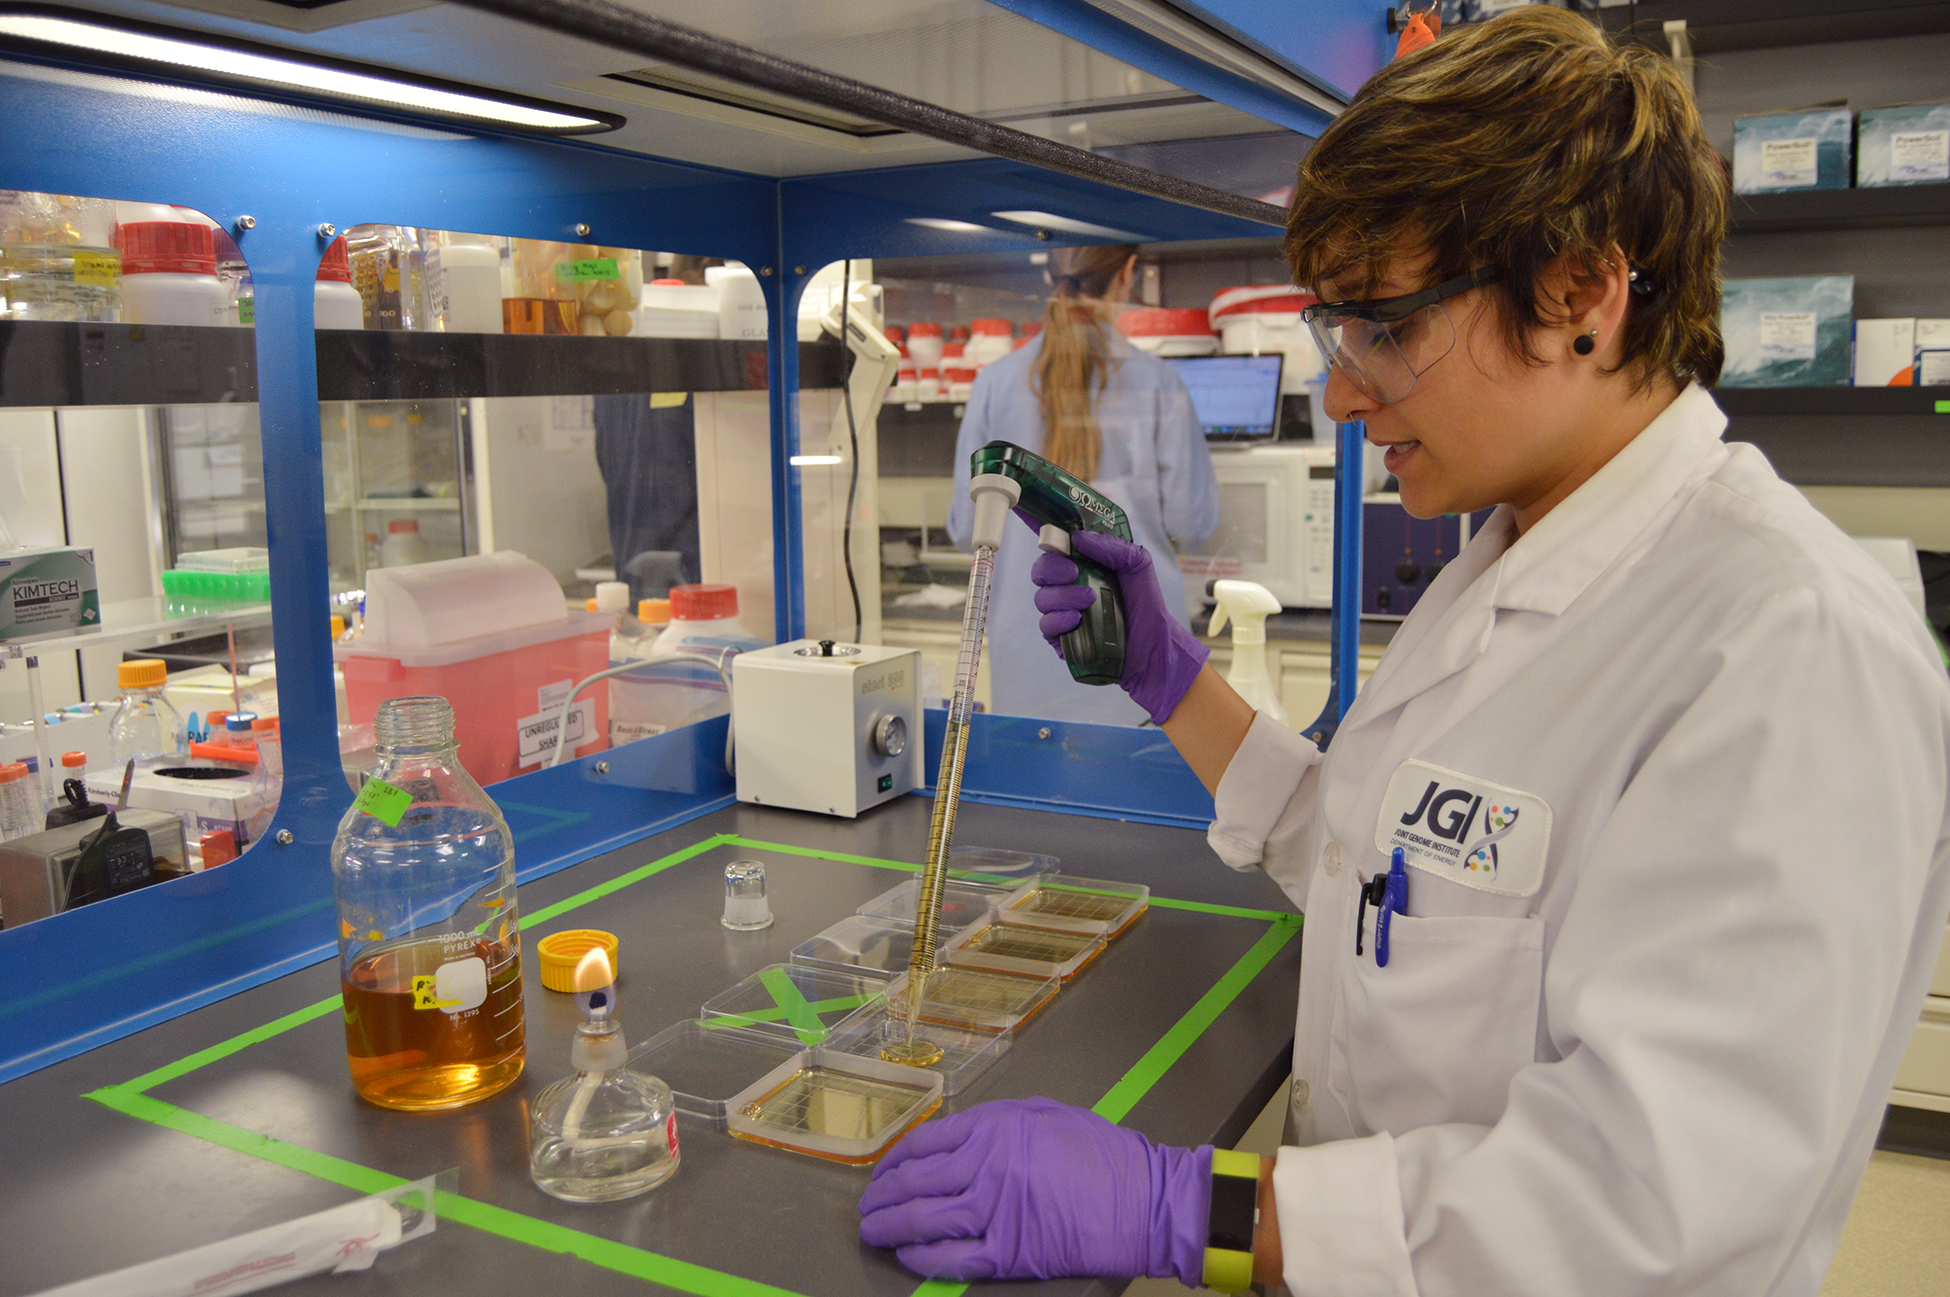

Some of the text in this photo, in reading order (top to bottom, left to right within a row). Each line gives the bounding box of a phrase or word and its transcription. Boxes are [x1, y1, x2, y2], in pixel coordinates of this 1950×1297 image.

[13, 579, 79, 600] KIMTECH
[524, 713, 578, 739] UNREGULED
[1400, 780, 1483, 845] JGI
[1389, 837, 1457, 867] DEPARTMENT OF ENERGY
[1393, 827, 1461, 858] JOINT GENOME INSTITUTE
[438, 930, 465, 944] 1000
[463, 1008, 480, 1018] 1395
